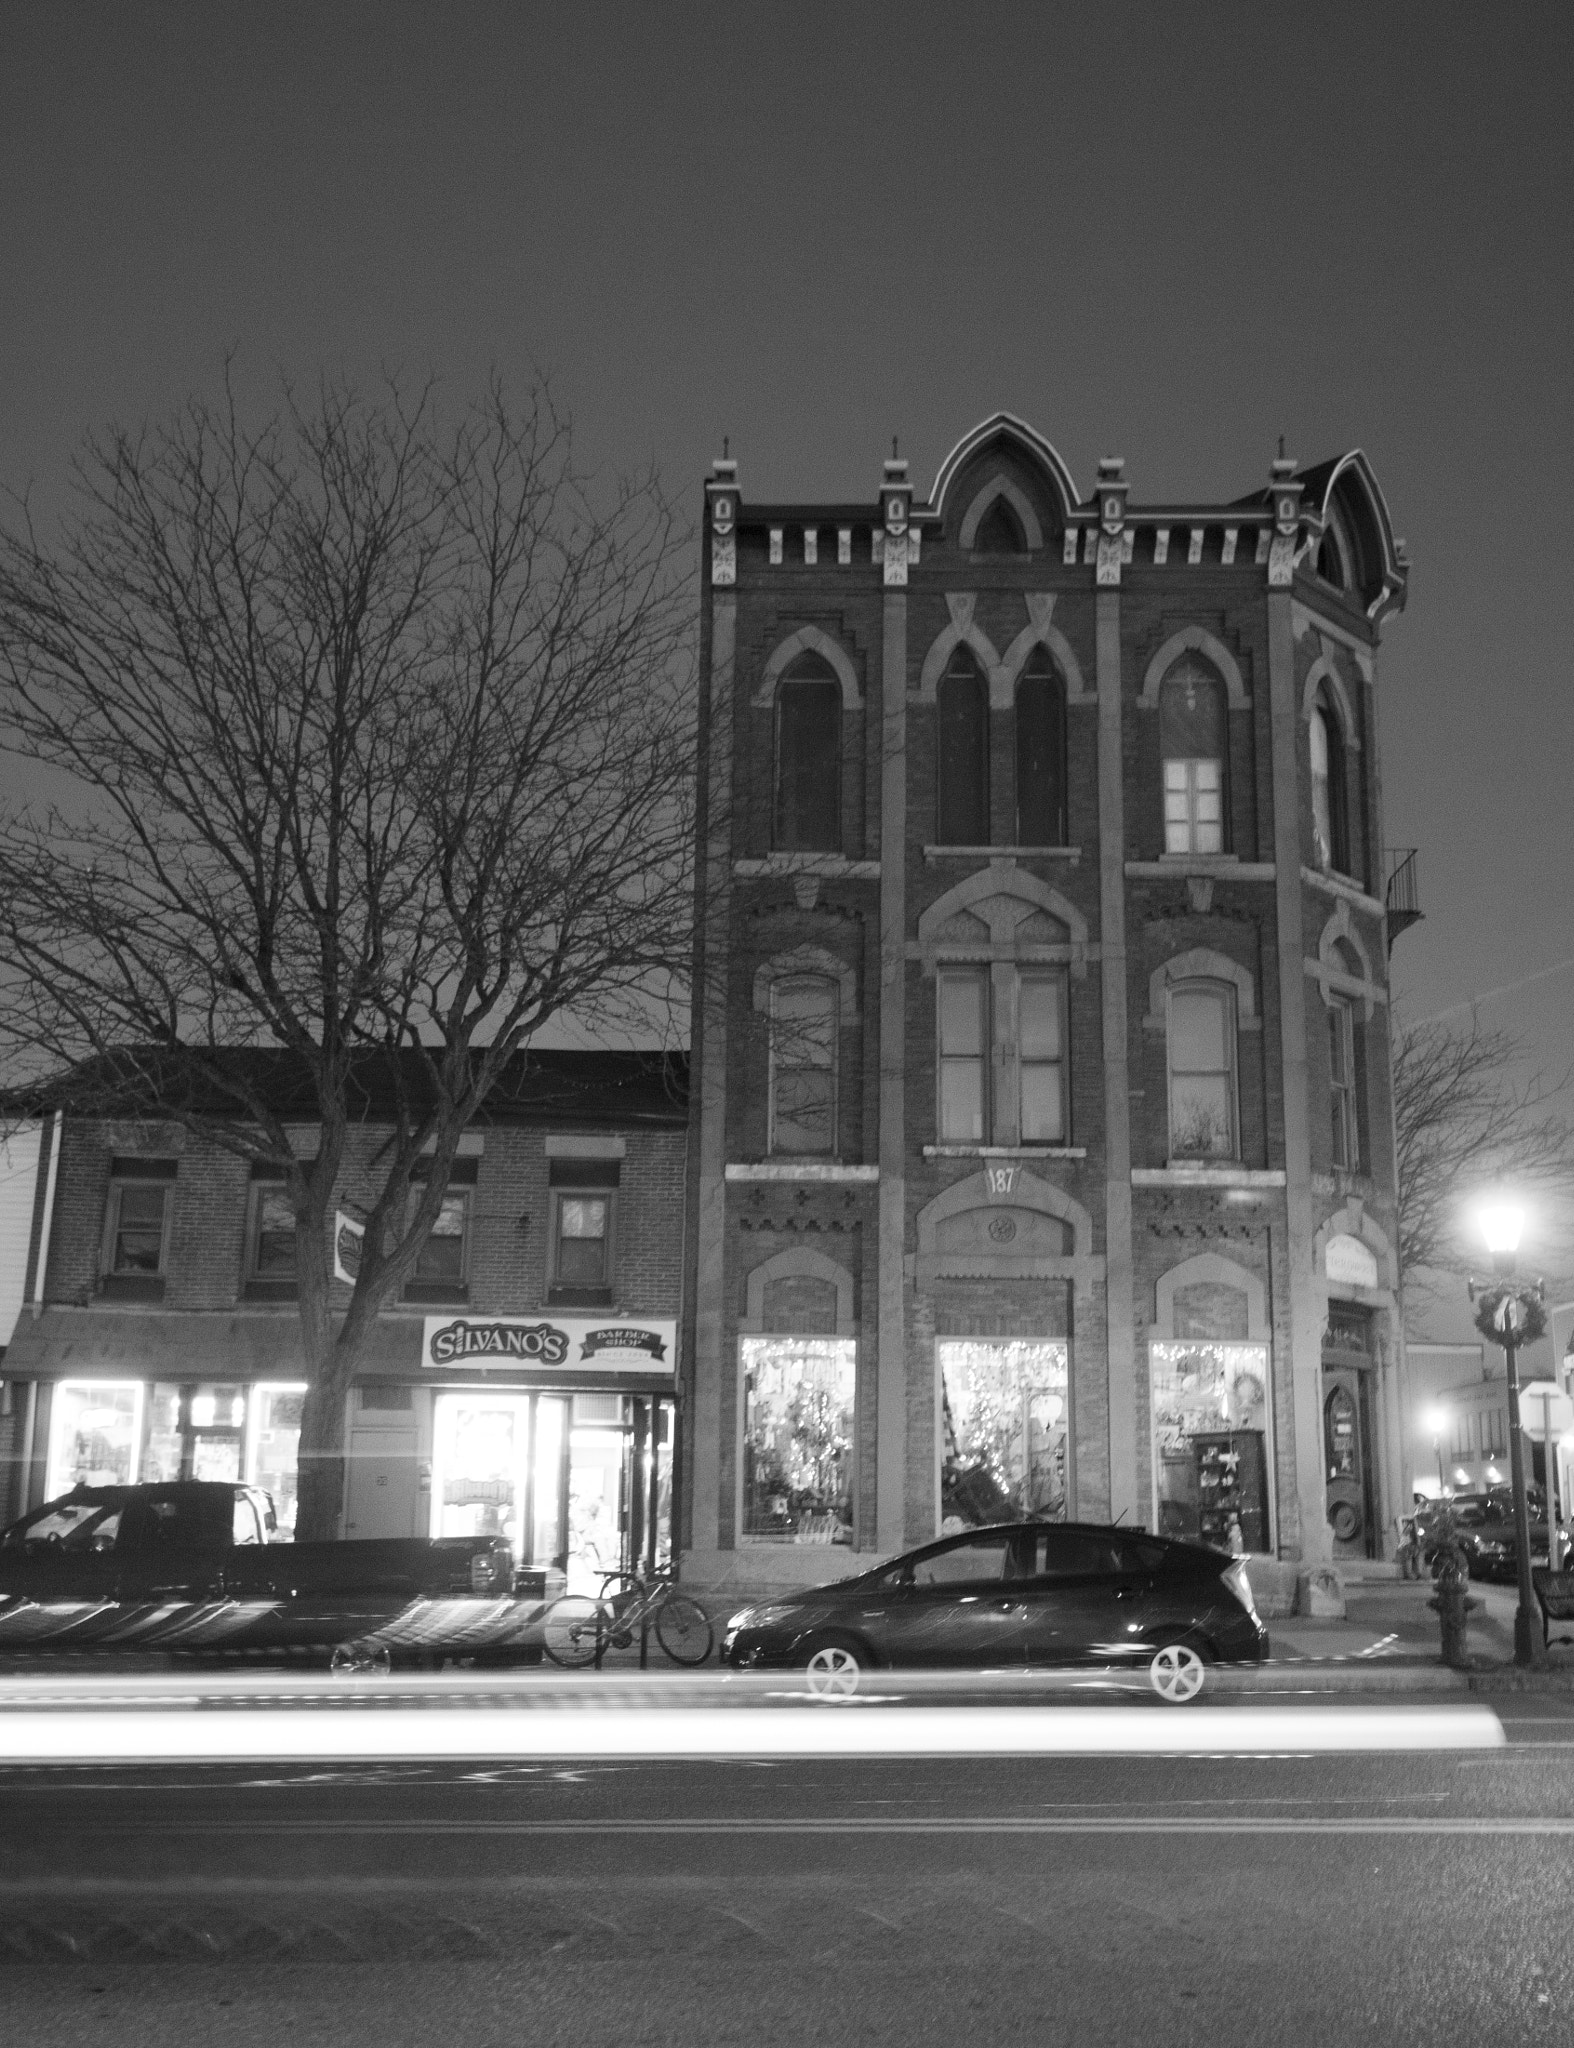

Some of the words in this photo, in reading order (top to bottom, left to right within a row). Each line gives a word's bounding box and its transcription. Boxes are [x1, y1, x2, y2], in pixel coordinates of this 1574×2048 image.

[988, 1167, 1015, 1194] 187
[596, 1329, 650, 1341] BARBER
[605, 1338, 642, 1348] SHOP
